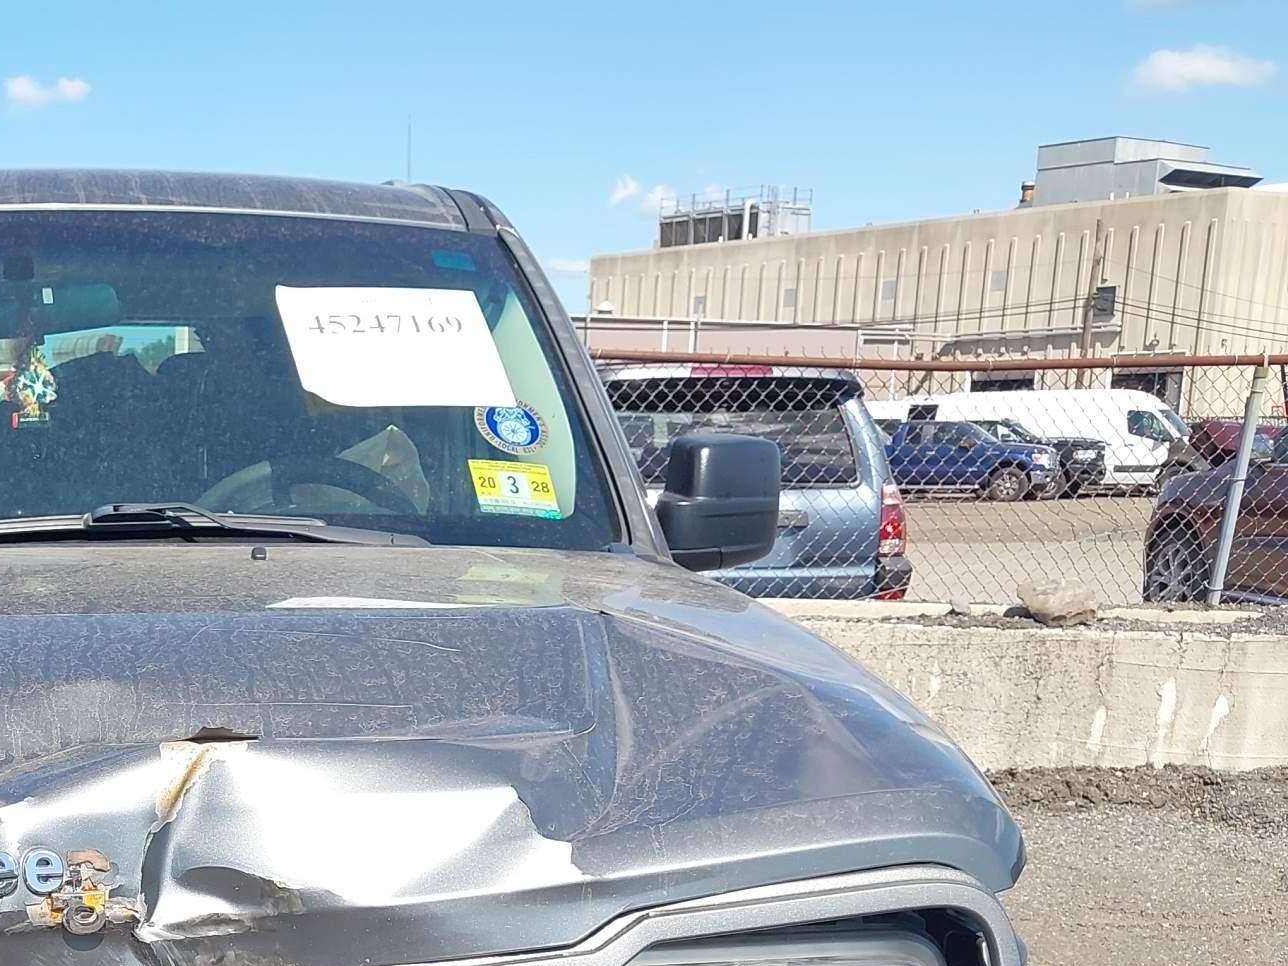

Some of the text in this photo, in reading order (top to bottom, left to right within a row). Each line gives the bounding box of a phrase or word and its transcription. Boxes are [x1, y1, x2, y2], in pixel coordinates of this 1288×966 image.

[309, 314, 463, 334] 45247169
[478, 475, 550, 494] 20 3 28
